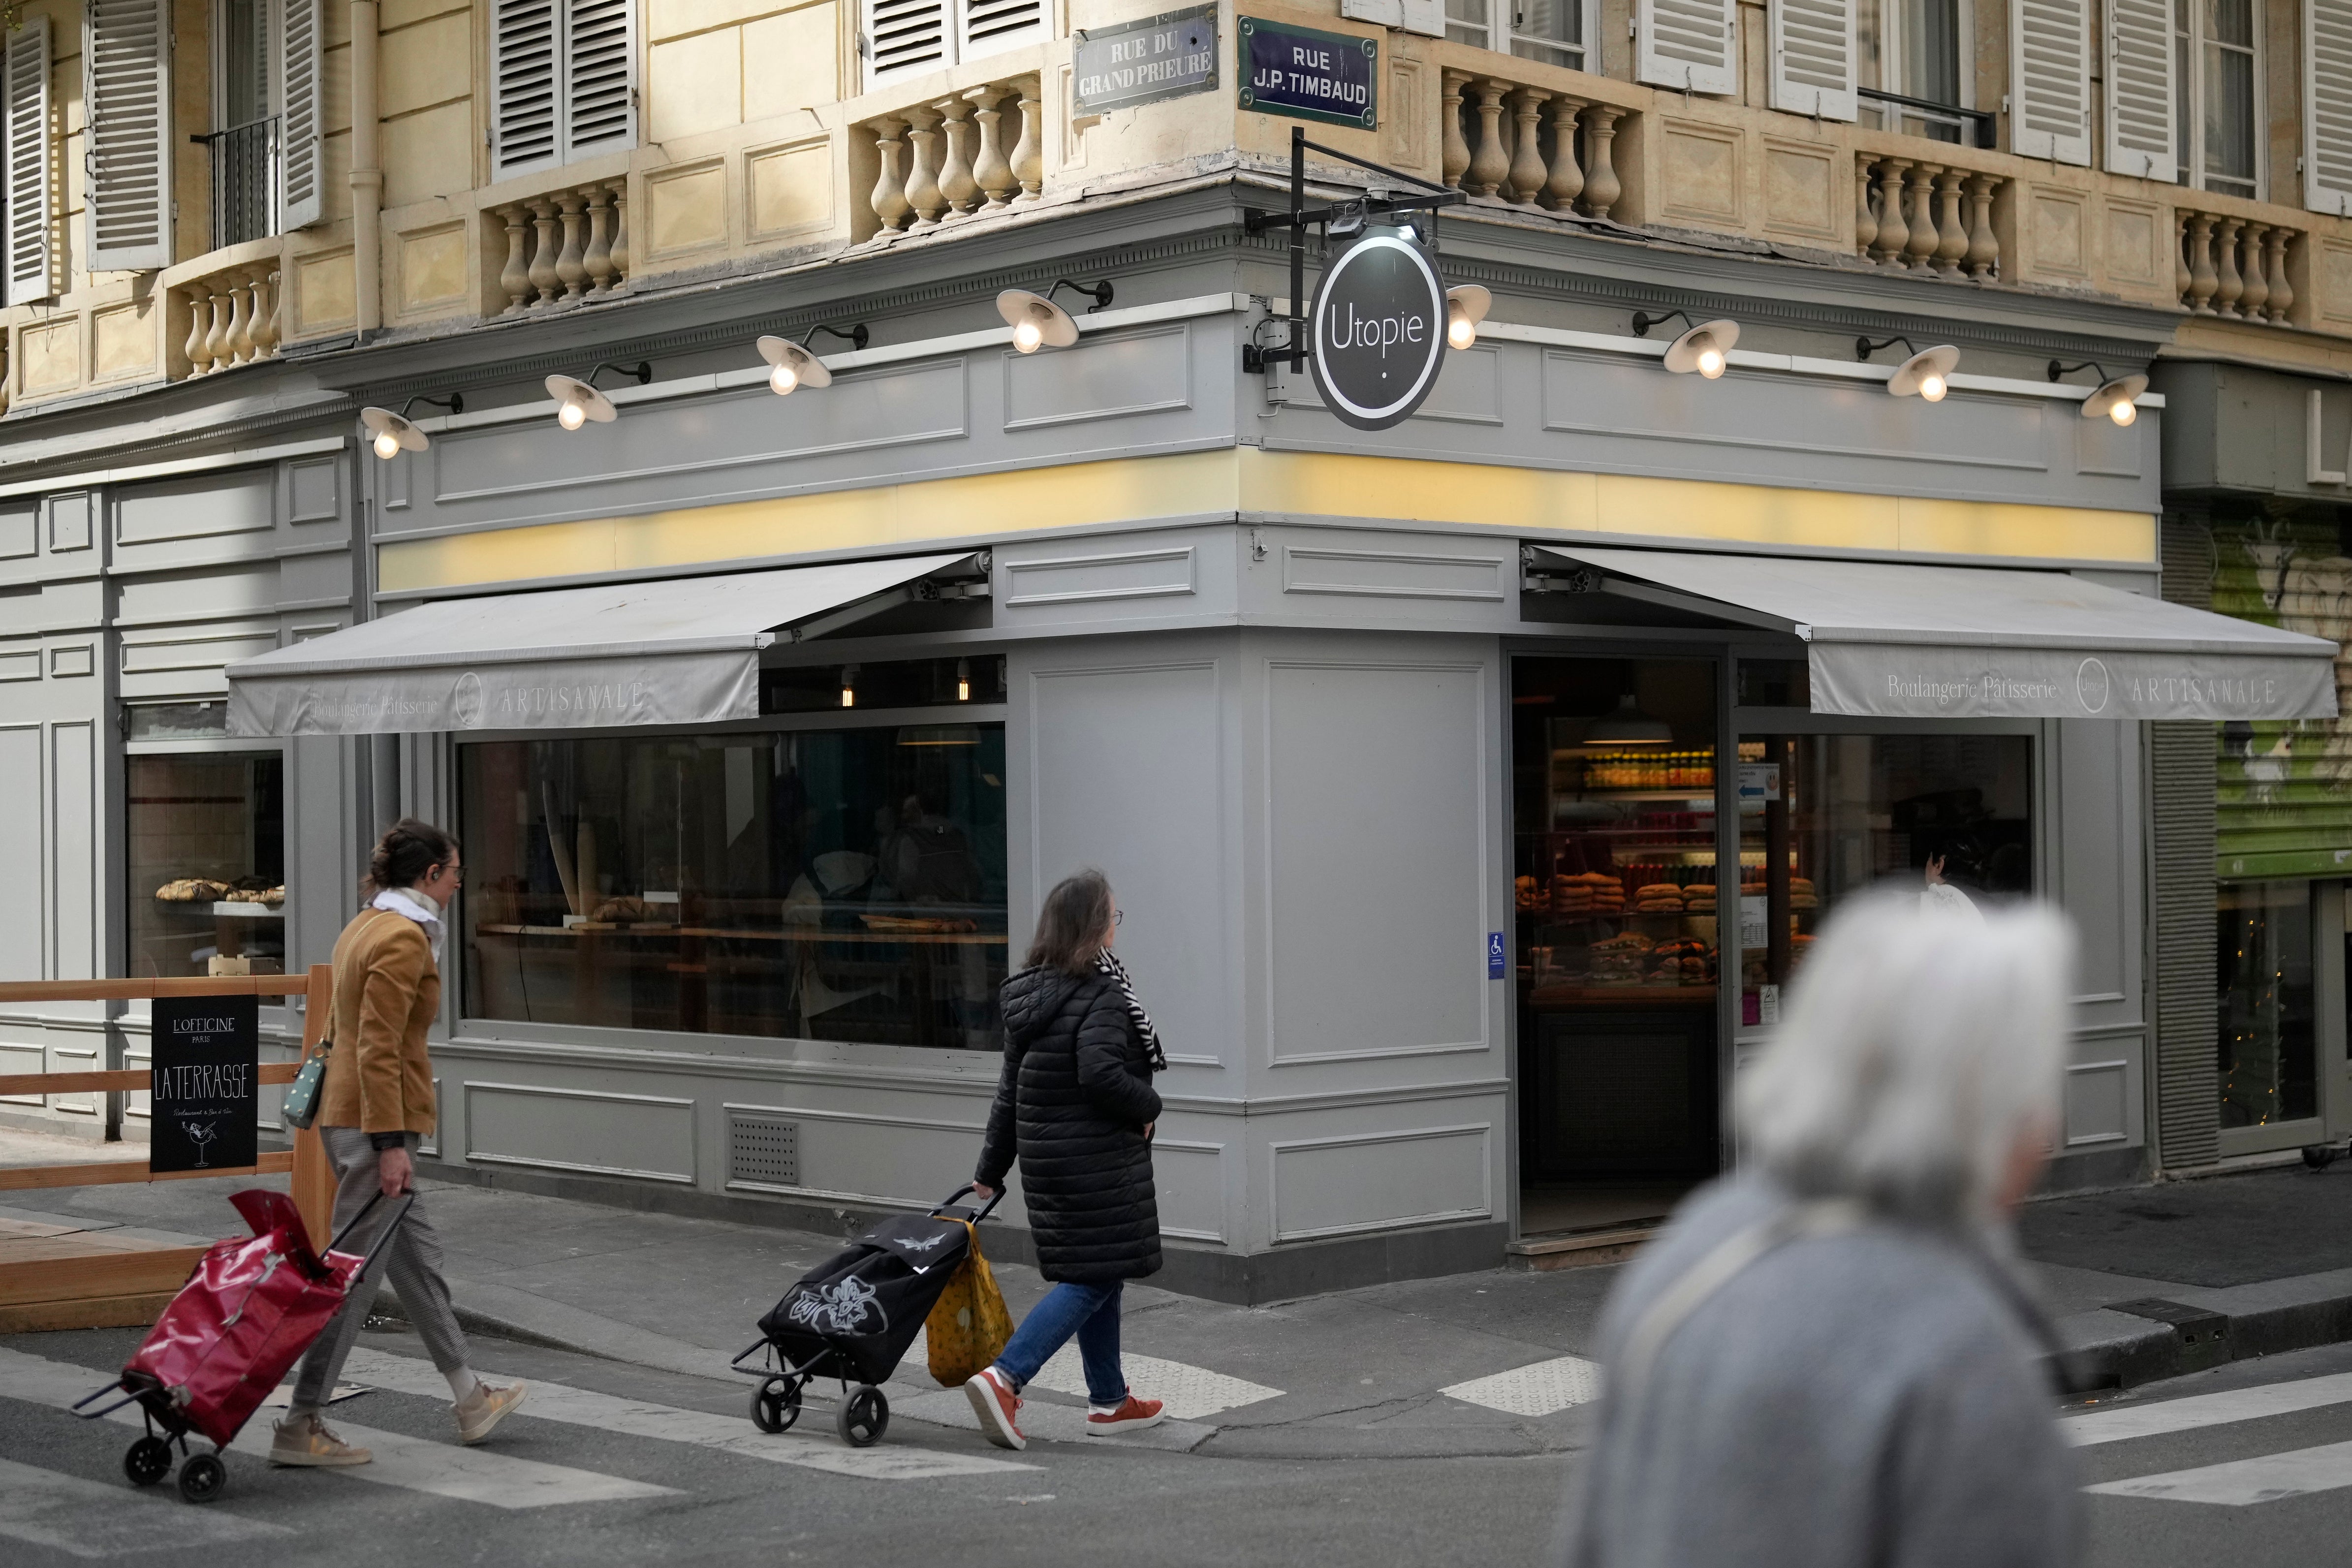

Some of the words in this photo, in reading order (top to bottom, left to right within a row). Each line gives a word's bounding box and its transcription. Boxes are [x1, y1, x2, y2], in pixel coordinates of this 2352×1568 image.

[1111, 37, 1146, 63] RUE
[1154, 31, 1178, 54] DU
[1293, 47, 1330, 70] RUE
[1079, 68, 1134, 96] GRAND
[1136, 45, 1211, 85] PRIEURÉ
[1288, 72, 1366, 104] TIMBAUD
[1332, 302, 1423, 359] Utopie
[502, 682, 642, 712] ARTISANALE
[1887, 674, 1977, 705] Boulangerie
[1983, 676, 2057, 698] Pâtisserie
[2132, 677, 2275, 703] ARTISANALE
[314, 697, 376, 722] Boulangerie
[381, 695, 437, 715] Pâtisserie
[173, 1017, 235, 1032] L'OFFICINE
[155, 1067, 172, 1100] LA
[173, 1064, 250, 1100] TERRASSE
